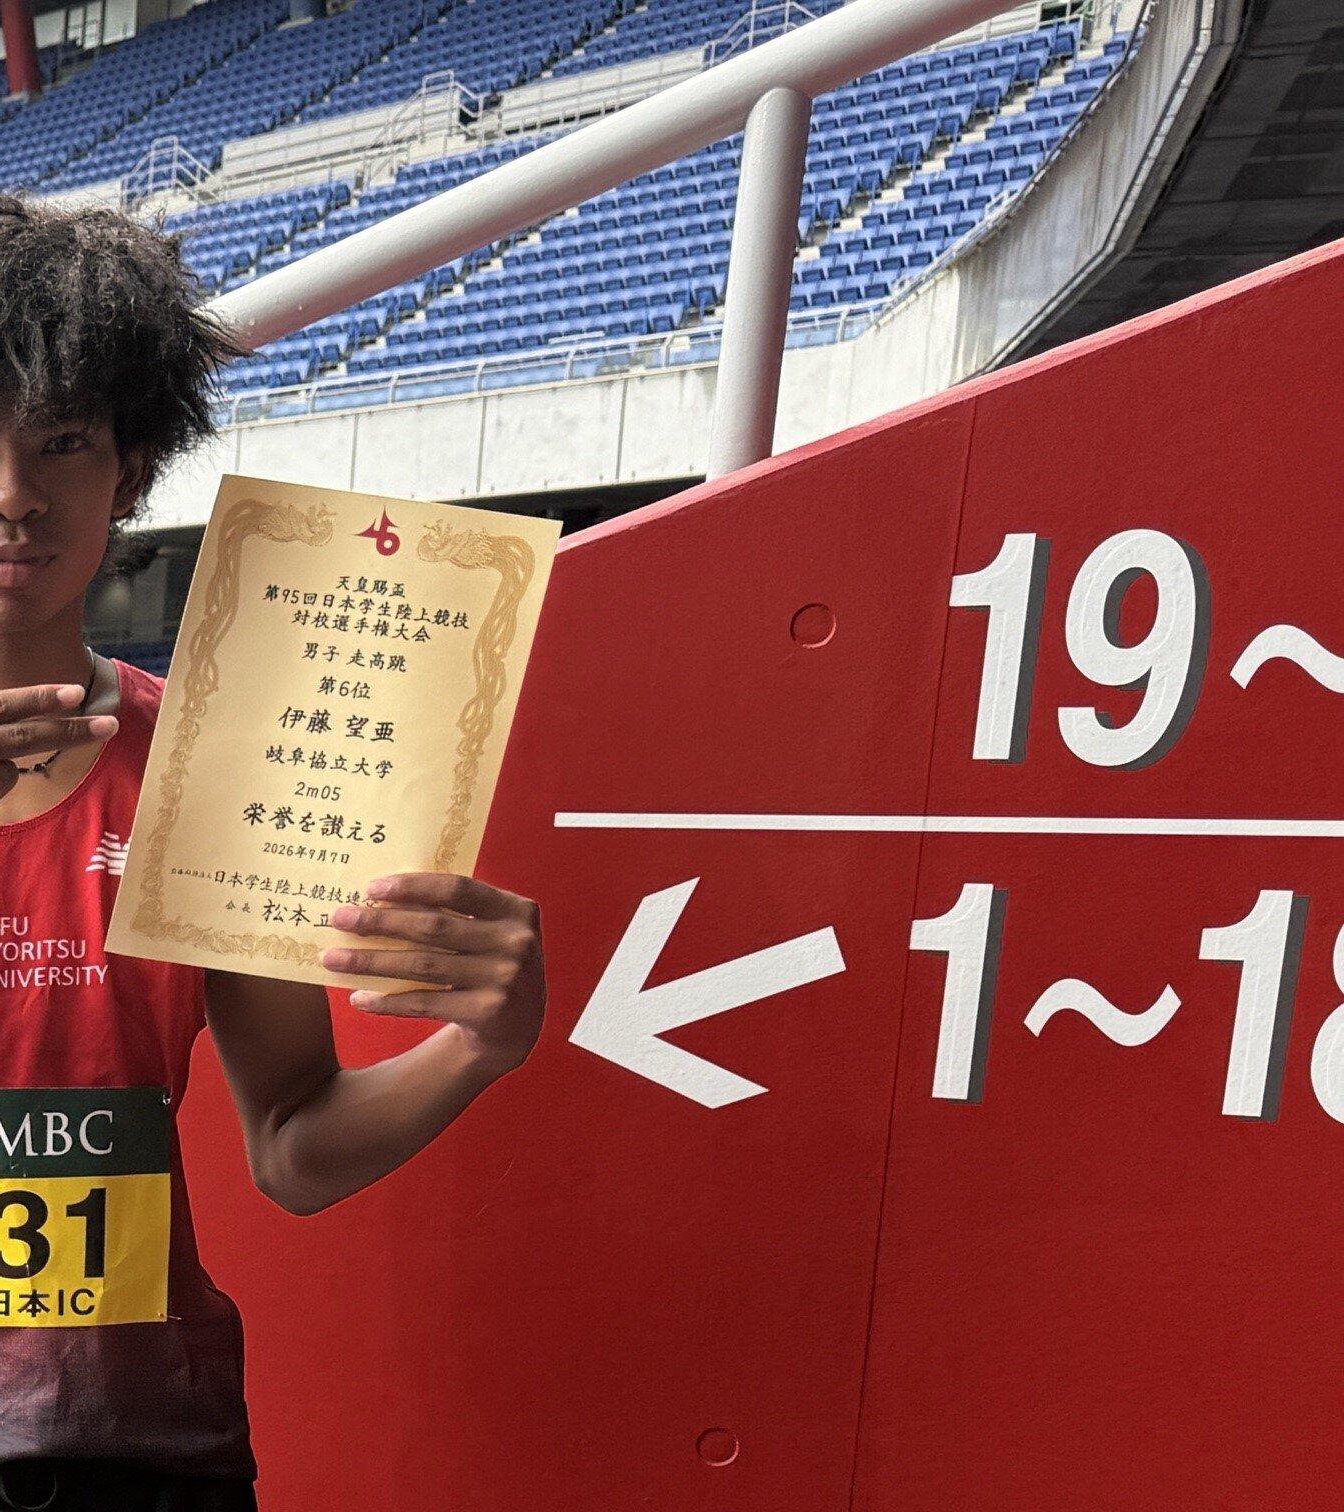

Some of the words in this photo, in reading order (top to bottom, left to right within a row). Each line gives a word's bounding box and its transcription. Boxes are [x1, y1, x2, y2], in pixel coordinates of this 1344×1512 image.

[263, 584, 470, 629] 第95回日本学生陸上競技
[291, 610, 431, 643] 対校選手権大会
[302, 642, 340, 662] 男子
[346, 649, 406, 673] 走高跳
[317, 676, 371, 699] 第6位
[278, 706, 332, 734] 伊藤
[344, 714, 395, 742] 望亜
[265, 745, 393, 779] 岐阜協立大学
[294, 781, 341, 801] 2m05
[263, 842, 350, 864] 2026年9月7日
